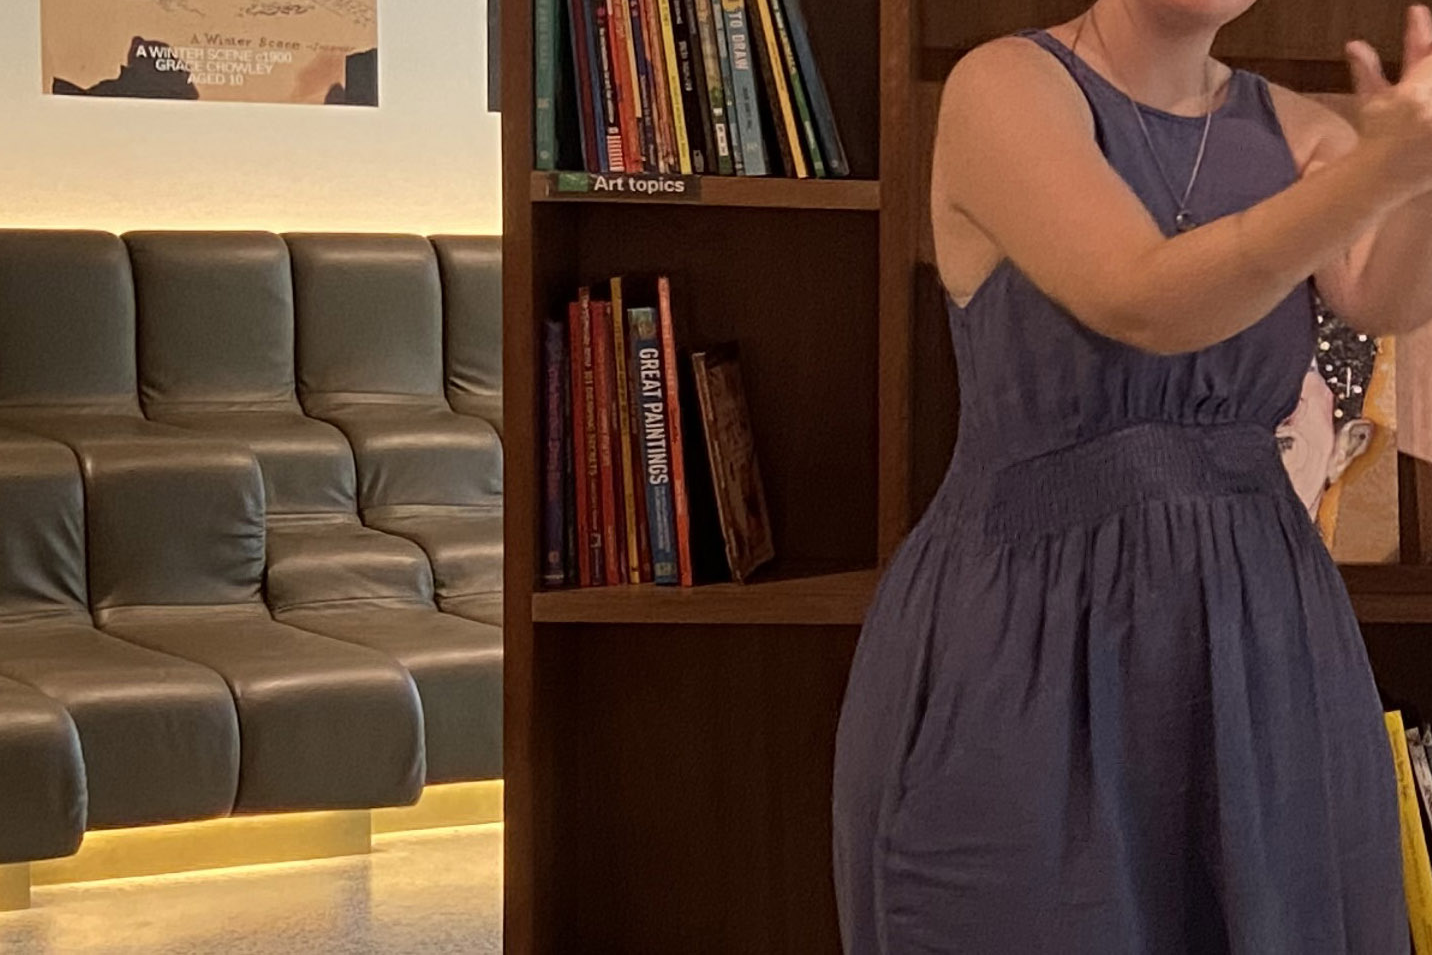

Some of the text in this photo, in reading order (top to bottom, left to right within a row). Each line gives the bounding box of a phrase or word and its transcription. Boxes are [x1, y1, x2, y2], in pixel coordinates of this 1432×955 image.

[729, 11, 743, 29] TO
[206, 33, 253, 47] Winter
[135, 46, 292, 64] A WINTER SCENE c1900
[732, 34, 749, 71] DRAW
[155, 59, 273, 75] GRACE CROWLEY
[187, 72, 244, 85] AGED 10
[593, 174, 685, 194] Art topics
[638, 348, 662, 398] GREAT
[642, 402, 668, 485] PAINTINGS
